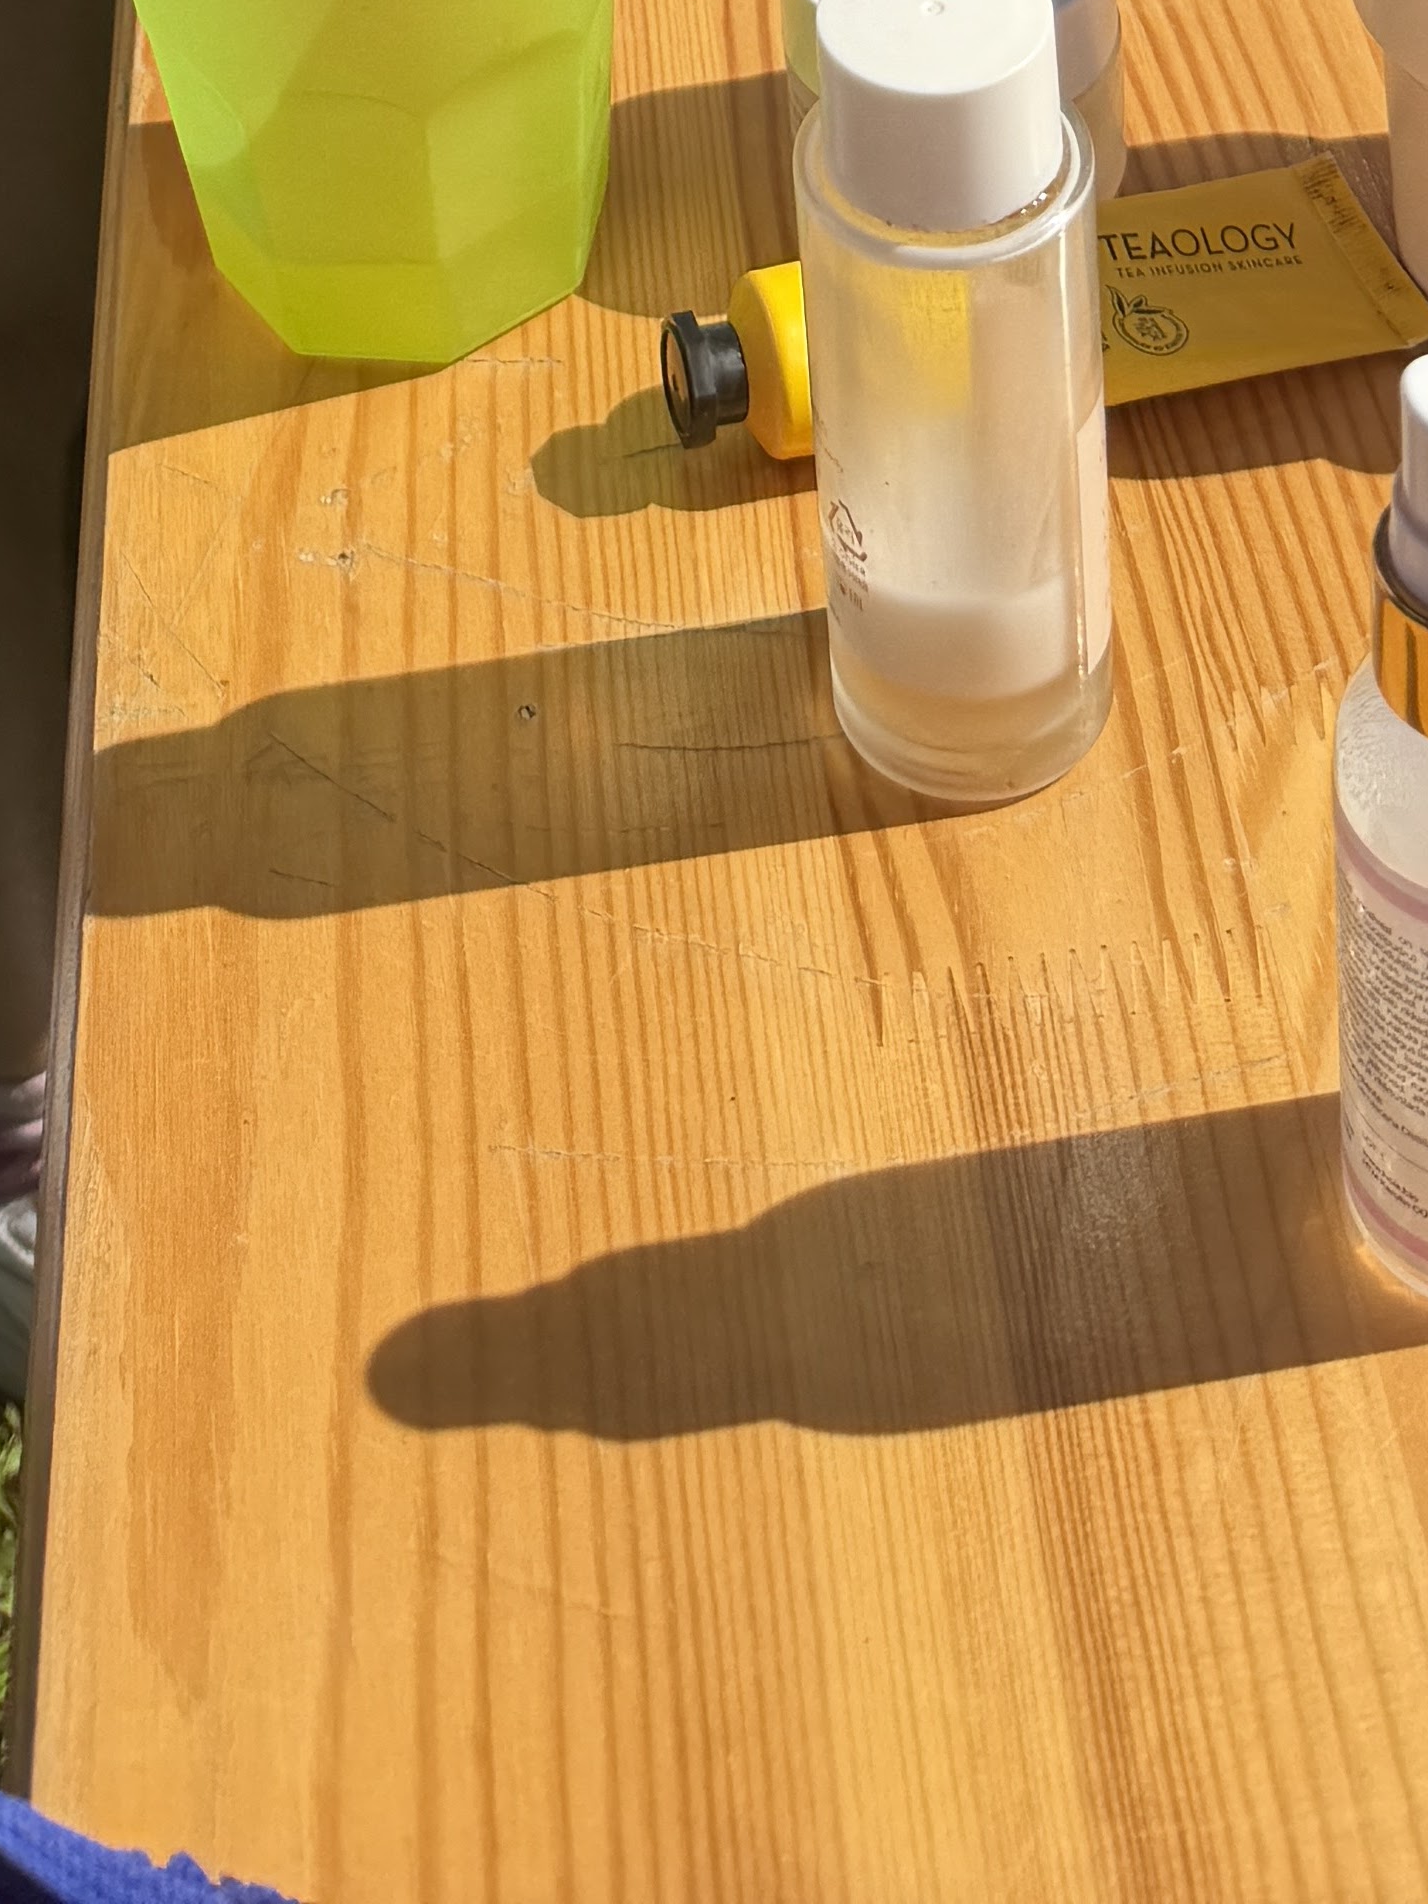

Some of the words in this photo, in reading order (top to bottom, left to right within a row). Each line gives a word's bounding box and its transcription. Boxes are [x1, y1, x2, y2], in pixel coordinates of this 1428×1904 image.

[1097, 222, 1296, 260] TEAOLOGY
[1116, 267, 1146, 279] TEA
[1150, 262, 1223, 276] INFUSION
[1228, 255, 1303, 271] SKINCARE
